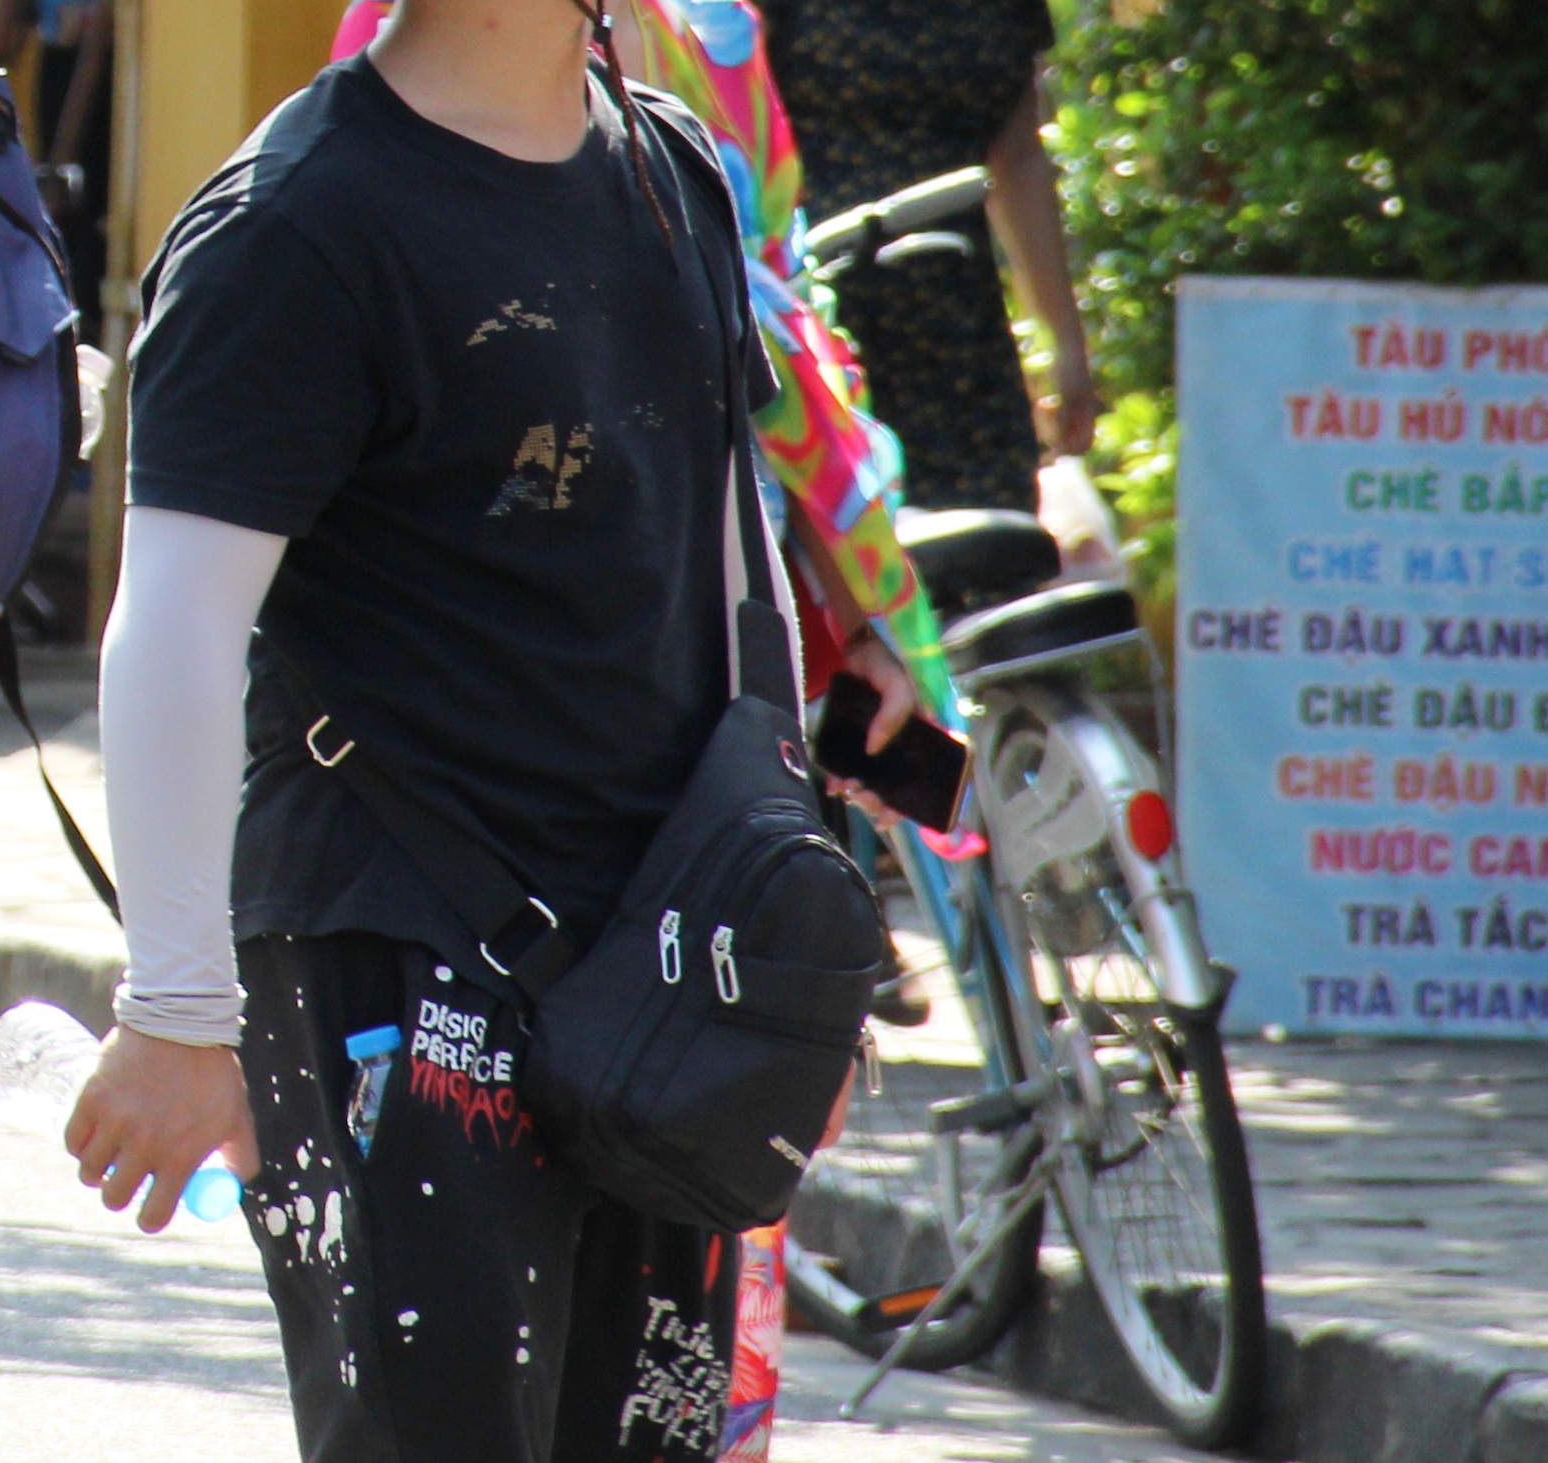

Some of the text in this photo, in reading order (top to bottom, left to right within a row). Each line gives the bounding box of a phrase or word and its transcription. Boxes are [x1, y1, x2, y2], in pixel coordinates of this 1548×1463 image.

[1350, 318, 1445, 370] TÀU
[1287, 387, 1382, 439] TÀU
[1345, 464, 1441, 512] CHÈ
[1189, 602, 1282, 652] CHÈ
[1303, 605, 1402, 663] ĐẬU
[1299, 680, 1394, 727] CHÈ
[1413, 681, 1515, 739] ĐẬU
[1277, 751, 1375, 799] CHÈ
[1393, 753, 1496, 812] ĐẬU
[1343, 895, 1436, 946] TRÀ
[1304, 972, 1394, 1017] TRÀ
